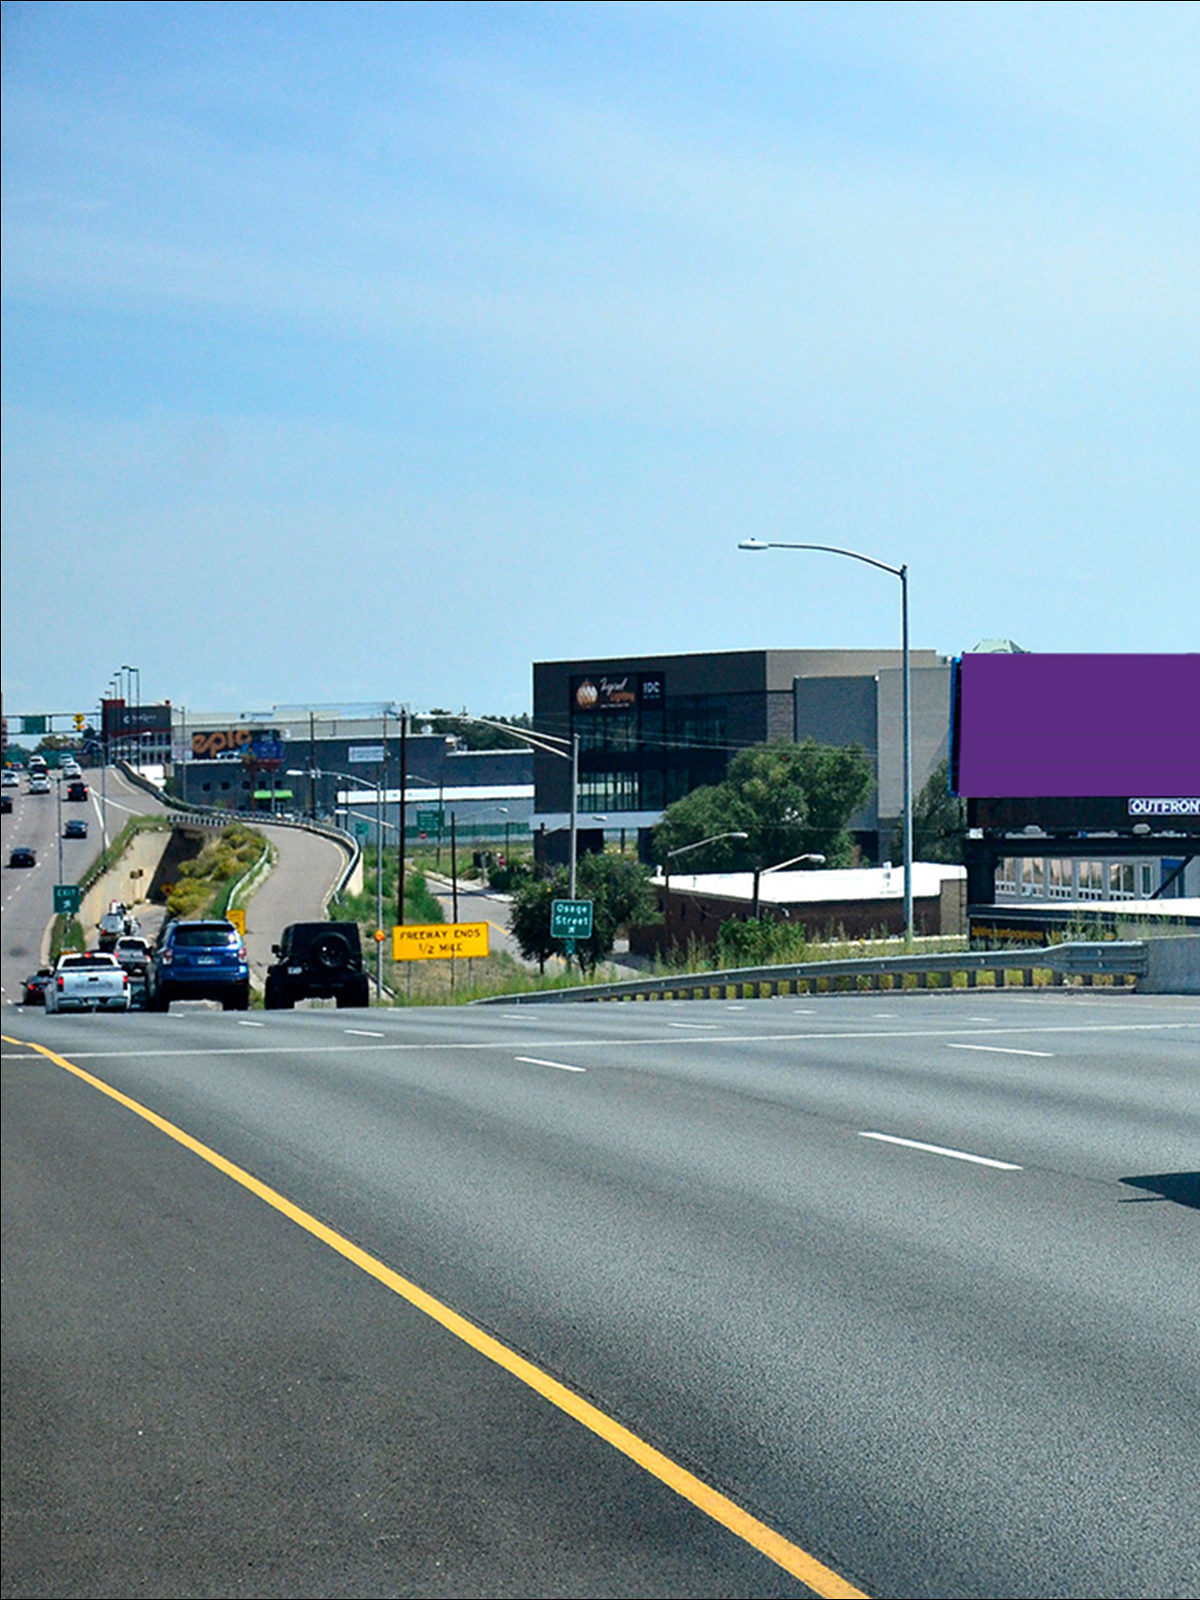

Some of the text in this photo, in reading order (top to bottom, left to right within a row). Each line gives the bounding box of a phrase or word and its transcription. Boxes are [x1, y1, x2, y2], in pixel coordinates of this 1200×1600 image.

[193, 730, 252, 759] epic
[57, 888, 76, 897] EXIT
[556, 904, 587, 914] Osage
[555, 915, 588, 925] Street
[400, 928, 481, 940] FREEWAY ENDS
[418, 943, 463, 954] 1/2 MILE
